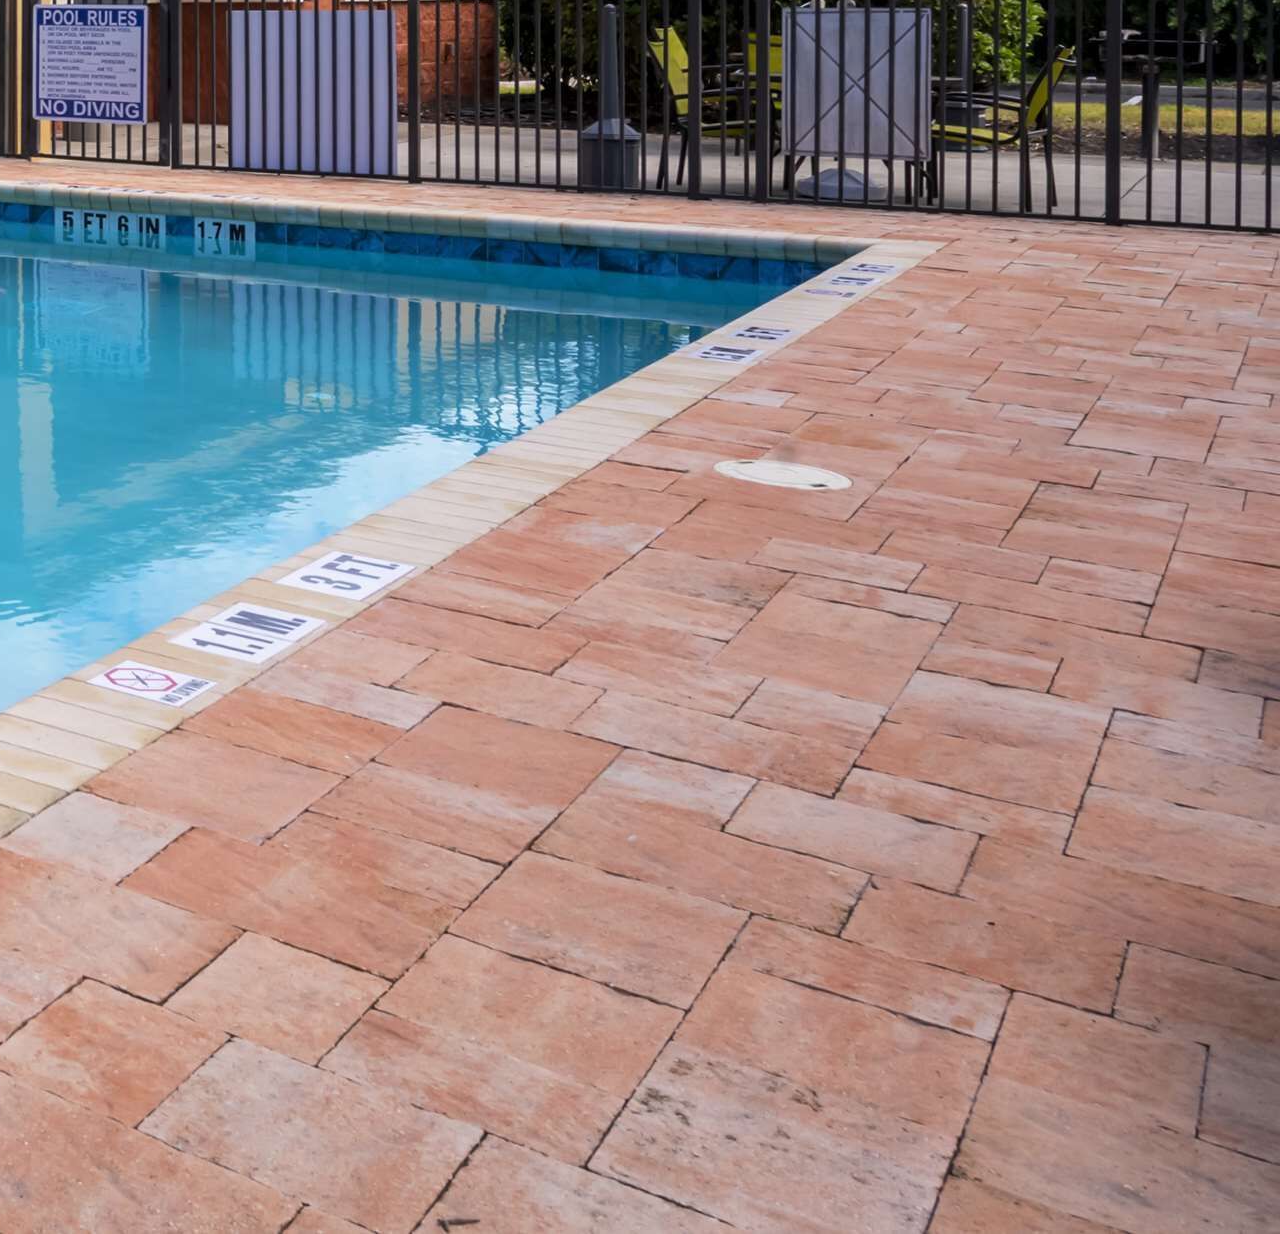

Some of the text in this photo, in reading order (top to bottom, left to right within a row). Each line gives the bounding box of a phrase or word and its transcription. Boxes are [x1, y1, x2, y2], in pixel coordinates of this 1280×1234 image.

[42, 9, 138, 27] POOL RULES
[40, 100, 140, 119] NO DIVING
[63, 211, 160, 234] 5 FT 6 IN
[229, 223, 245, 241] M
[300, 554, 400, 590] 3 FT.
[192, 610, 308, 655] 1.1 M.
